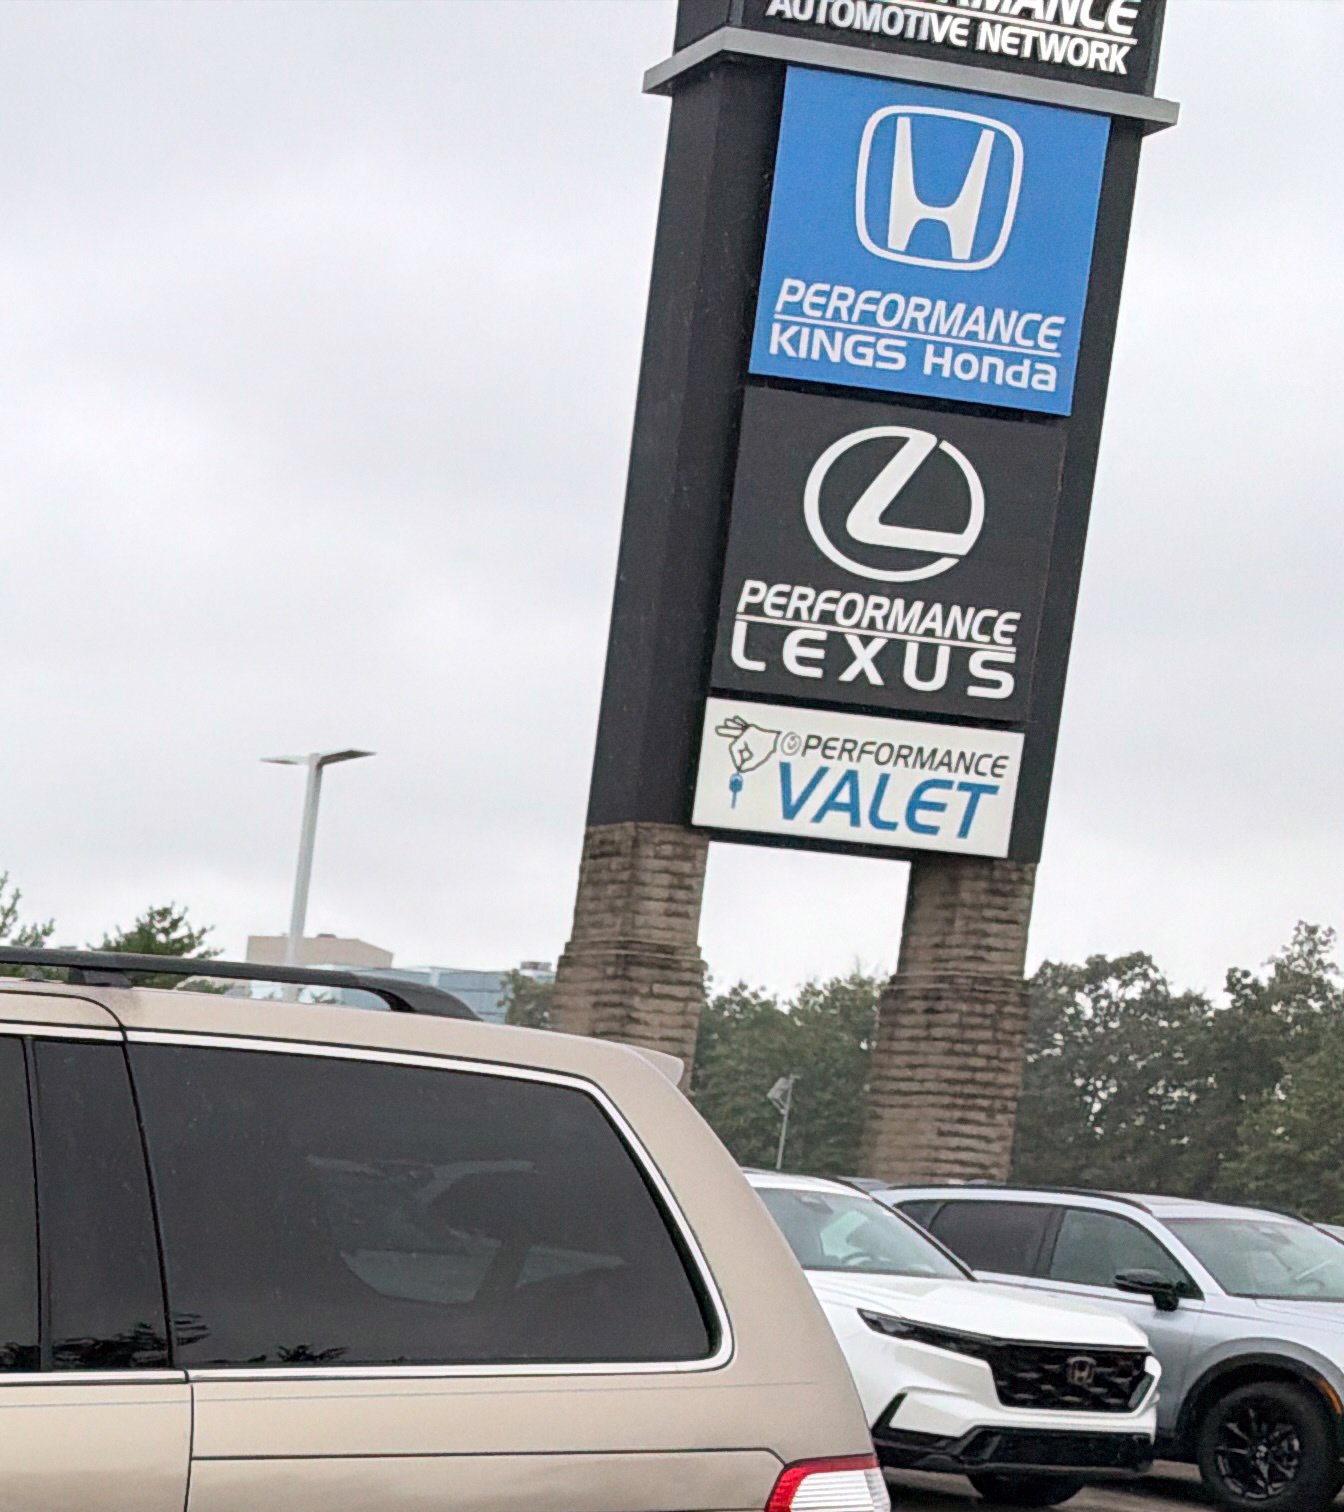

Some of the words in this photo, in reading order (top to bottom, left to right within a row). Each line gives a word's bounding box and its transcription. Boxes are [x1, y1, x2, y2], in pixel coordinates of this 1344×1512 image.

[765, 0, 971, 48] AUTOMOTIVE
[976, 20, 1132, 75] NETWORK
[774, 277, 1066, 350] PERFORMANCE
[769, 322, 908, 371] KINGS
[923, 343, 1057, 392] Honda
[736, 579, 1021, 645] PERFORMANCE
[731, 620, 1016, 699] LEXUS
[801, 735, 1009, 778] PERFORMANCE
[779, 761, 1000, 839] VALET
